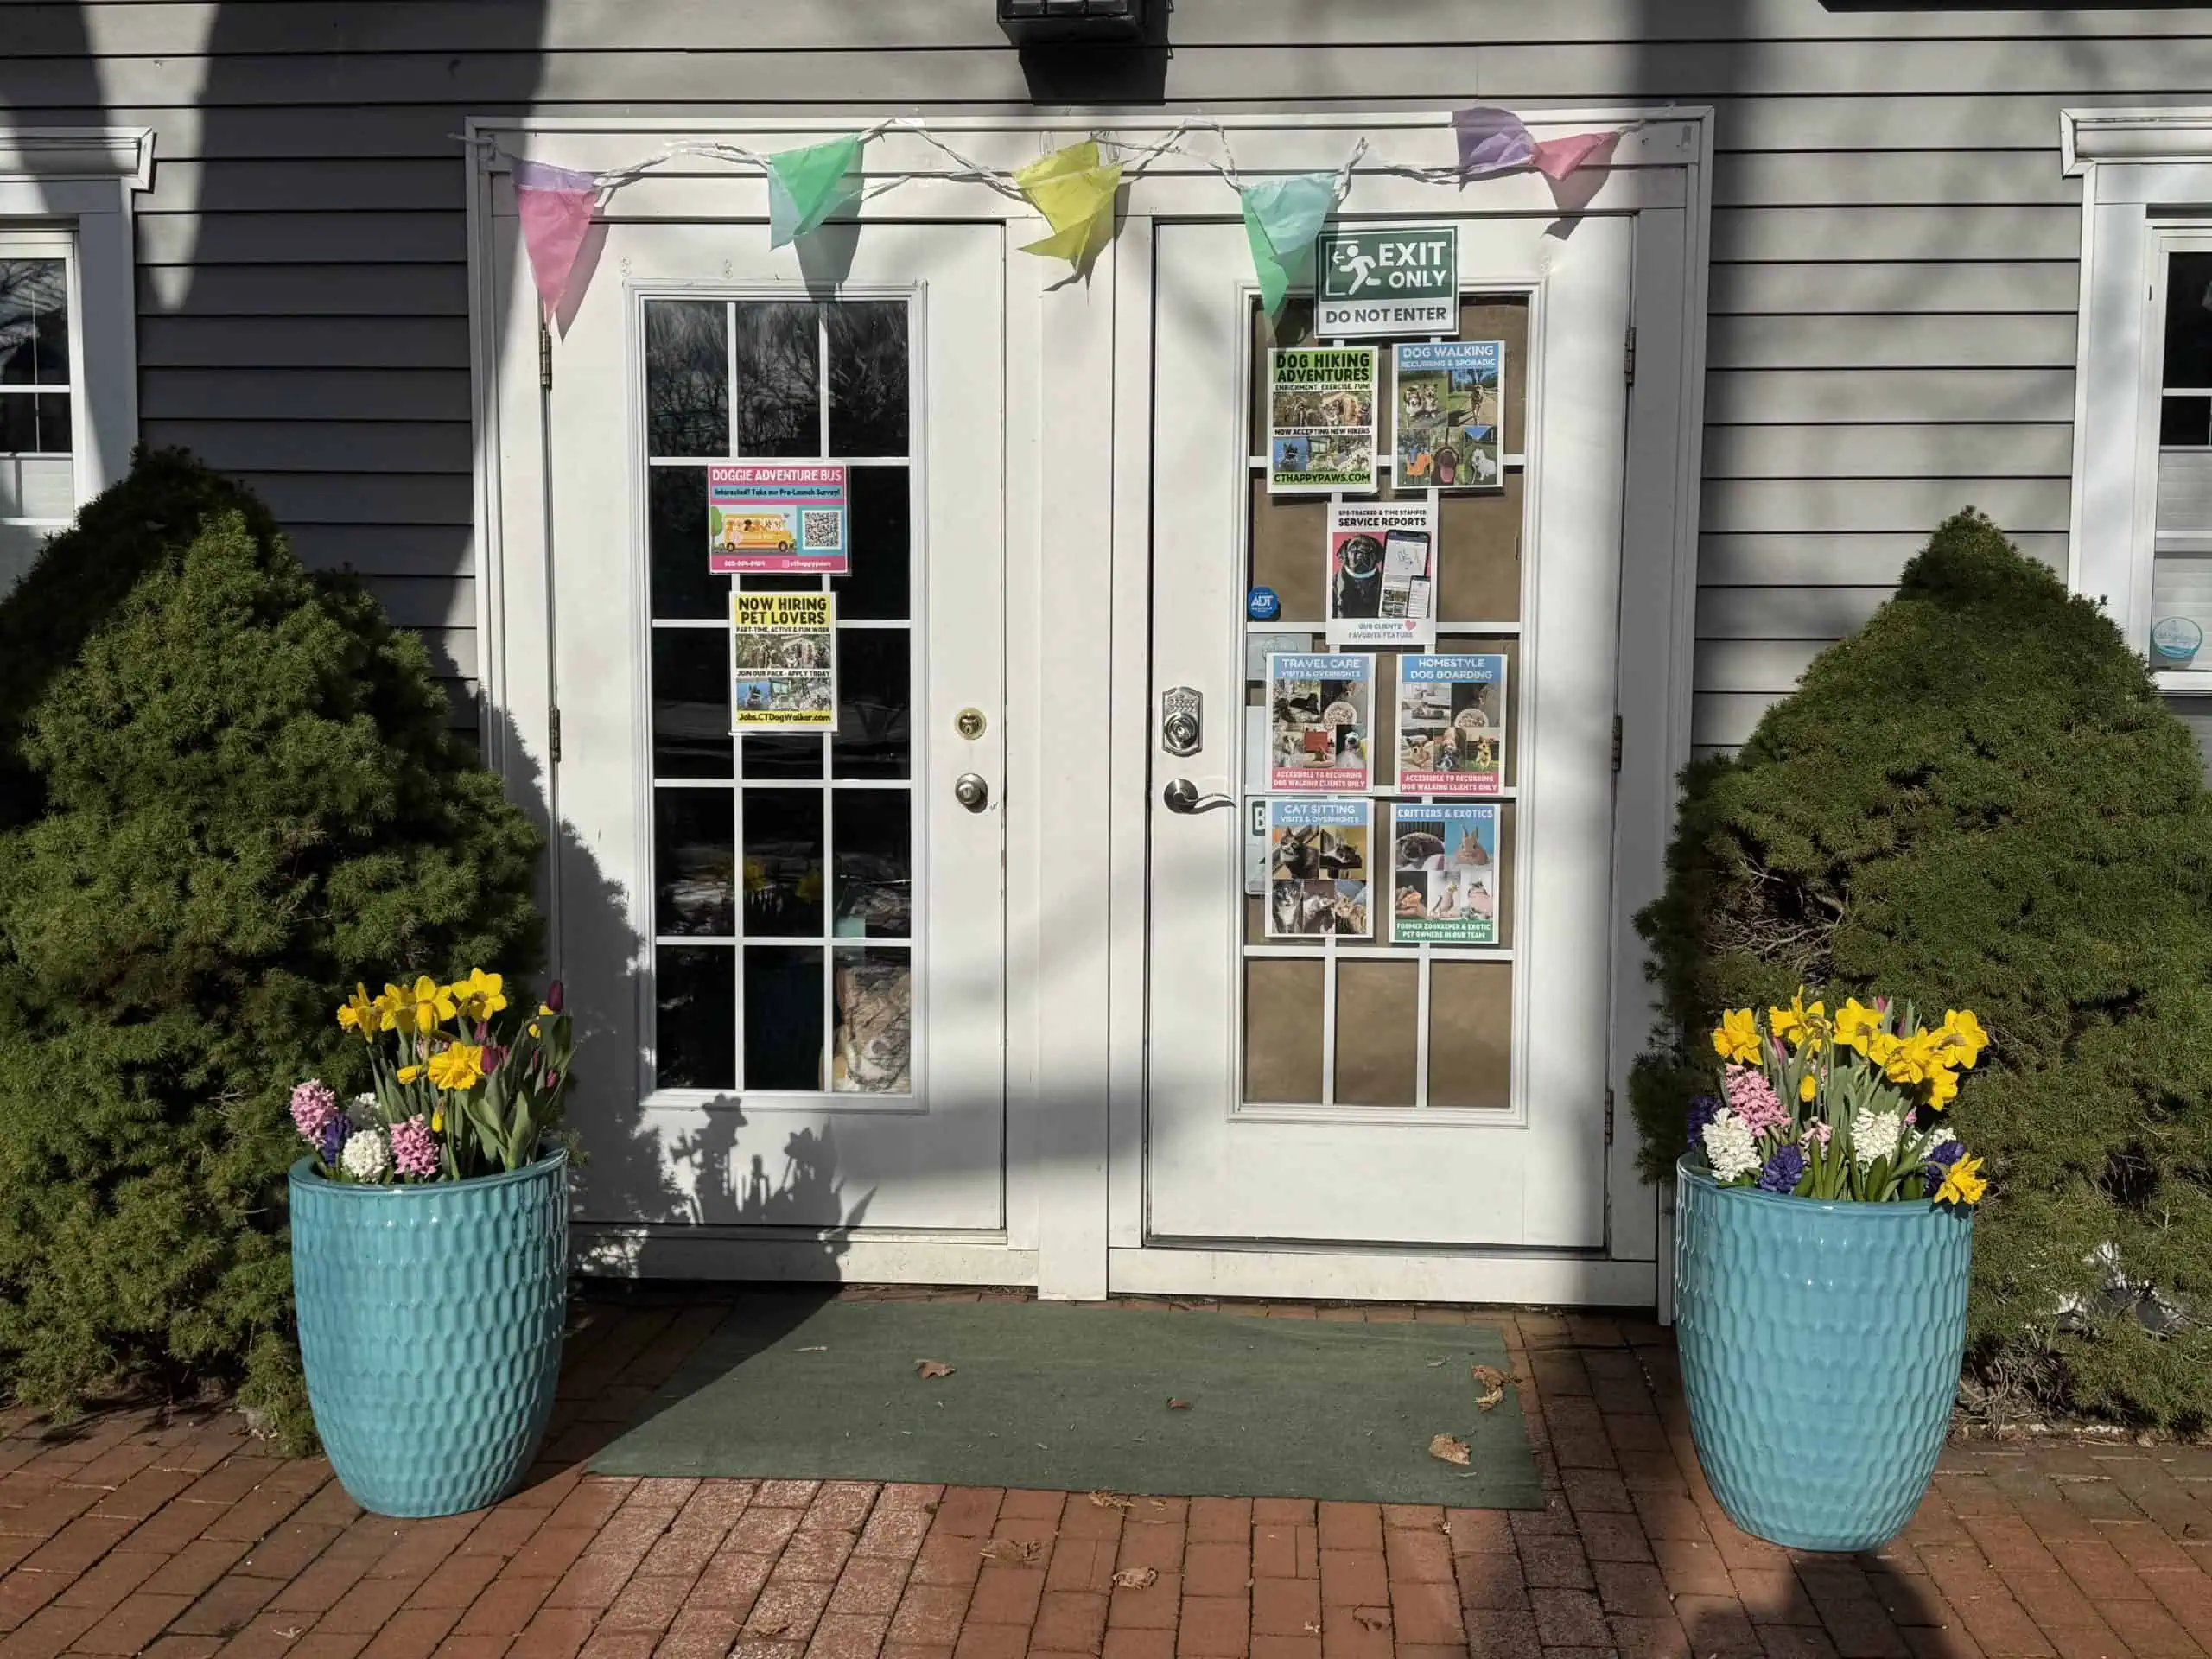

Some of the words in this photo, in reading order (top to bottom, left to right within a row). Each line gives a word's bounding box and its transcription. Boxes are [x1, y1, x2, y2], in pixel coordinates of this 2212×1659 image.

[1379, 241, 1446, 267] EXIT
[1389, 270, 1447, 289] ONLY
[1325, 310, 1351, 324] DO
[1354, 308, 1391, 323] NOT
[1394, 307, 1447, 321] ENTER
[1402, 346, 1432, 359] DOG
[1434, 345, 1494, 357] WALKING
[1276, 353, 1309, 369] DOG
[1313, 353, 1370, 368] HIKING
[1277, 368, 1370, 383] ADVENTURES
[712, 469, 753, 481] DOGGIE
[754, 469, 818, 481] ADVENTURE
[820, 469, 842, 481] BUS
[1274, 473, 1370, 483] CTHAPPYPAWS.COM
[816, 488, 841, 497] Survey!
[1338, 518, 1380, 526] SERVICE
[1381, 518, 1427, 526] REPORTS
[738, 597, 774, 611] NOW
[778, 597, 827, 611] HIRING
[1250, 595, 1274, 607] ADT
[741, 611, 768, 624] PET
[770, 611, 825, 624] LOVERS
[1281, 658, 1328, 669] TRAVEL
[1330, 658, 1363, 669] CARE
[1418, 658, 1486, 668] HOMESTYLE
[1409, 670, 1434, 680] DOG
[1436, 670, 1493, 680] BOARDING
[1284, 804, 1307, 814] CAT
[1312, 804, 1356, 814] SITTING
[1397, 808, 1443, 818] CRITTERS
[1444, 809, 1452, 818] &
[1453, 809, 1494, 818] EXOTICS
